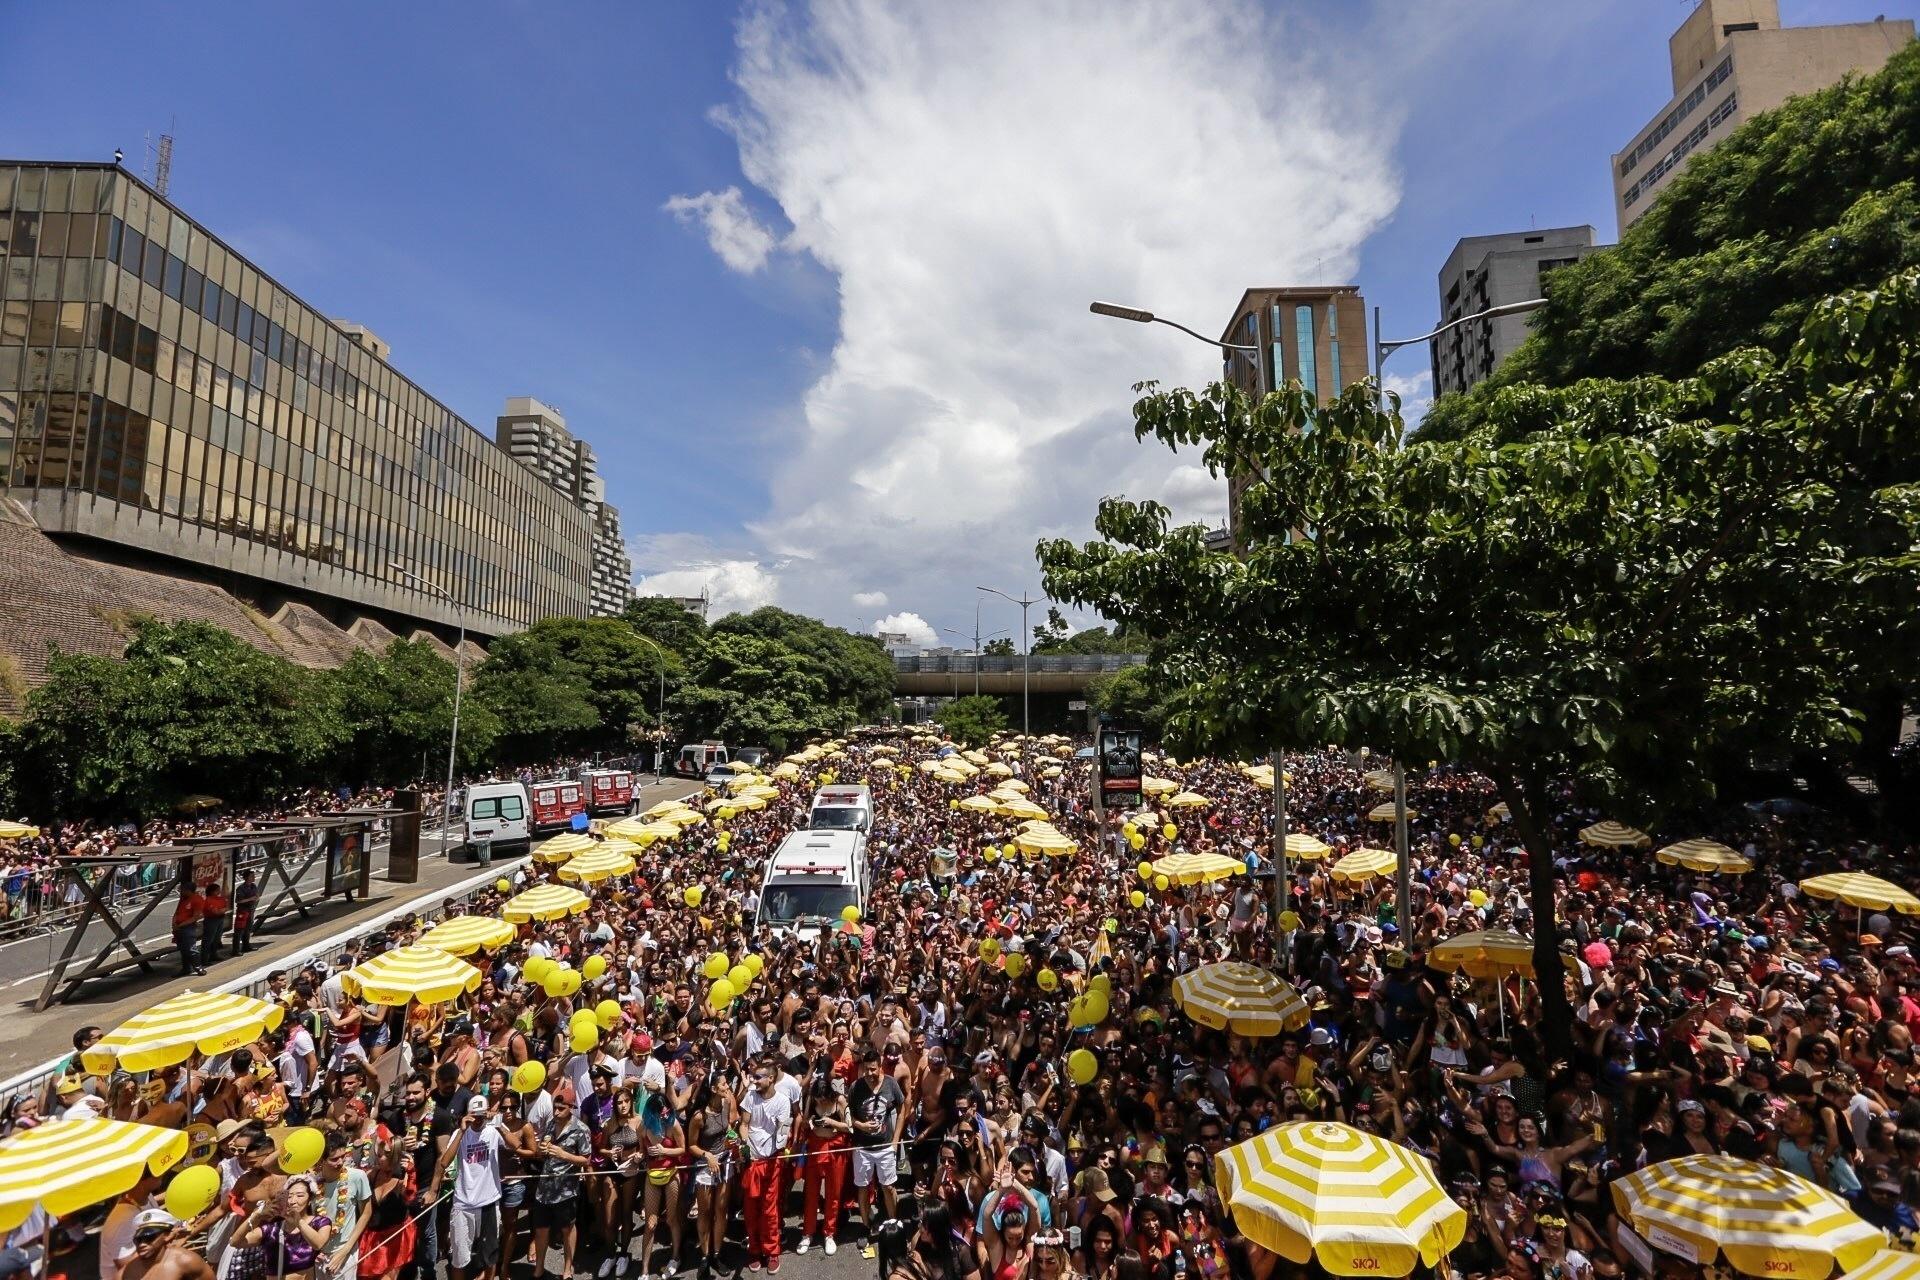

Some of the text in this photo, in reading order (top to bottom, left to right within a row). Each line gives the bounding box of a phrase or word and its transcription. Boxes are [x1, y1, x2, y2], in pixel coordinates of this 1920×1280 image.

[222, 1037, 240, 1049] SKOL
[1353, 1258, 1380, 1270] SKOL
[1765, 1261, 1795, 1272] SKOL
